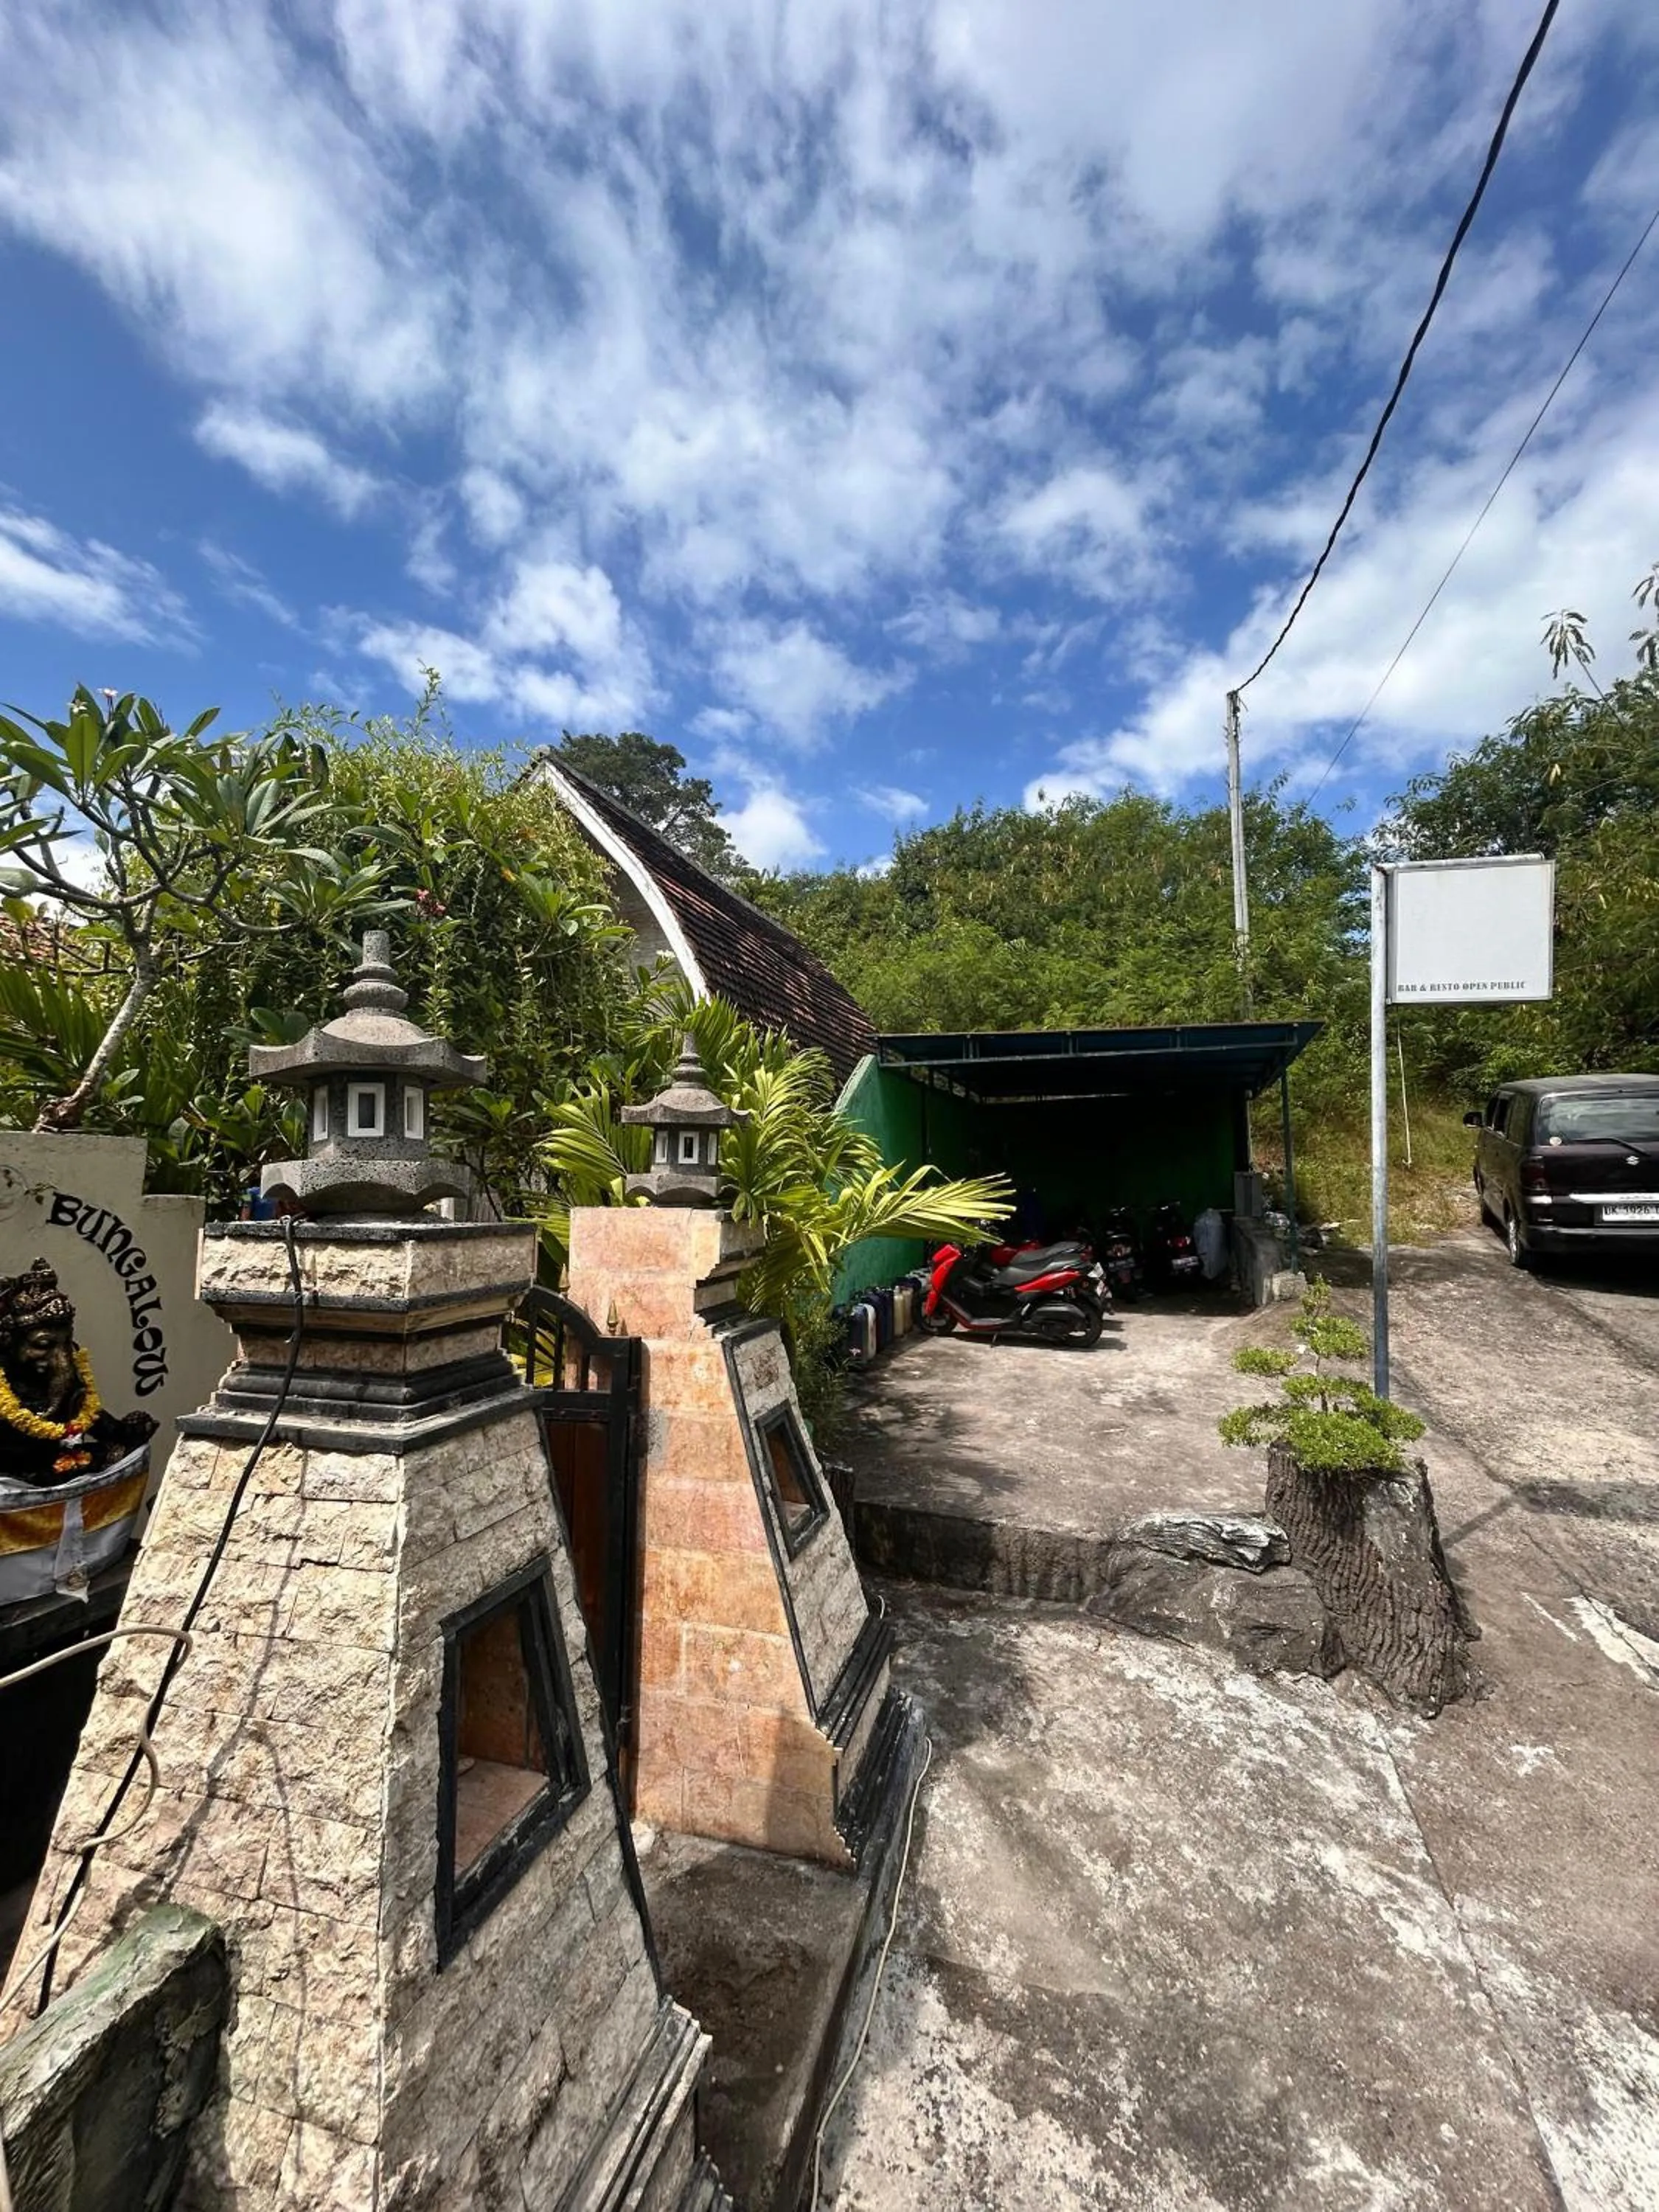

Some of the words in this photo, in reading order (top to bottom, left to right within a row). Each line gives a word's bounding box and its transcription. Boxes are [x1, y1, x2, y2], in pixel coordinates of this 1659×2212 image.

[1397, 984, 1417, 992] BAR
[1419, 984, 1427, 992] &
[1462, 982, 1488, 990] OPEN
[1490, 981, 1525, 990] PUBLIC
[45, 1191, 169, 1397] BUNGALOW
